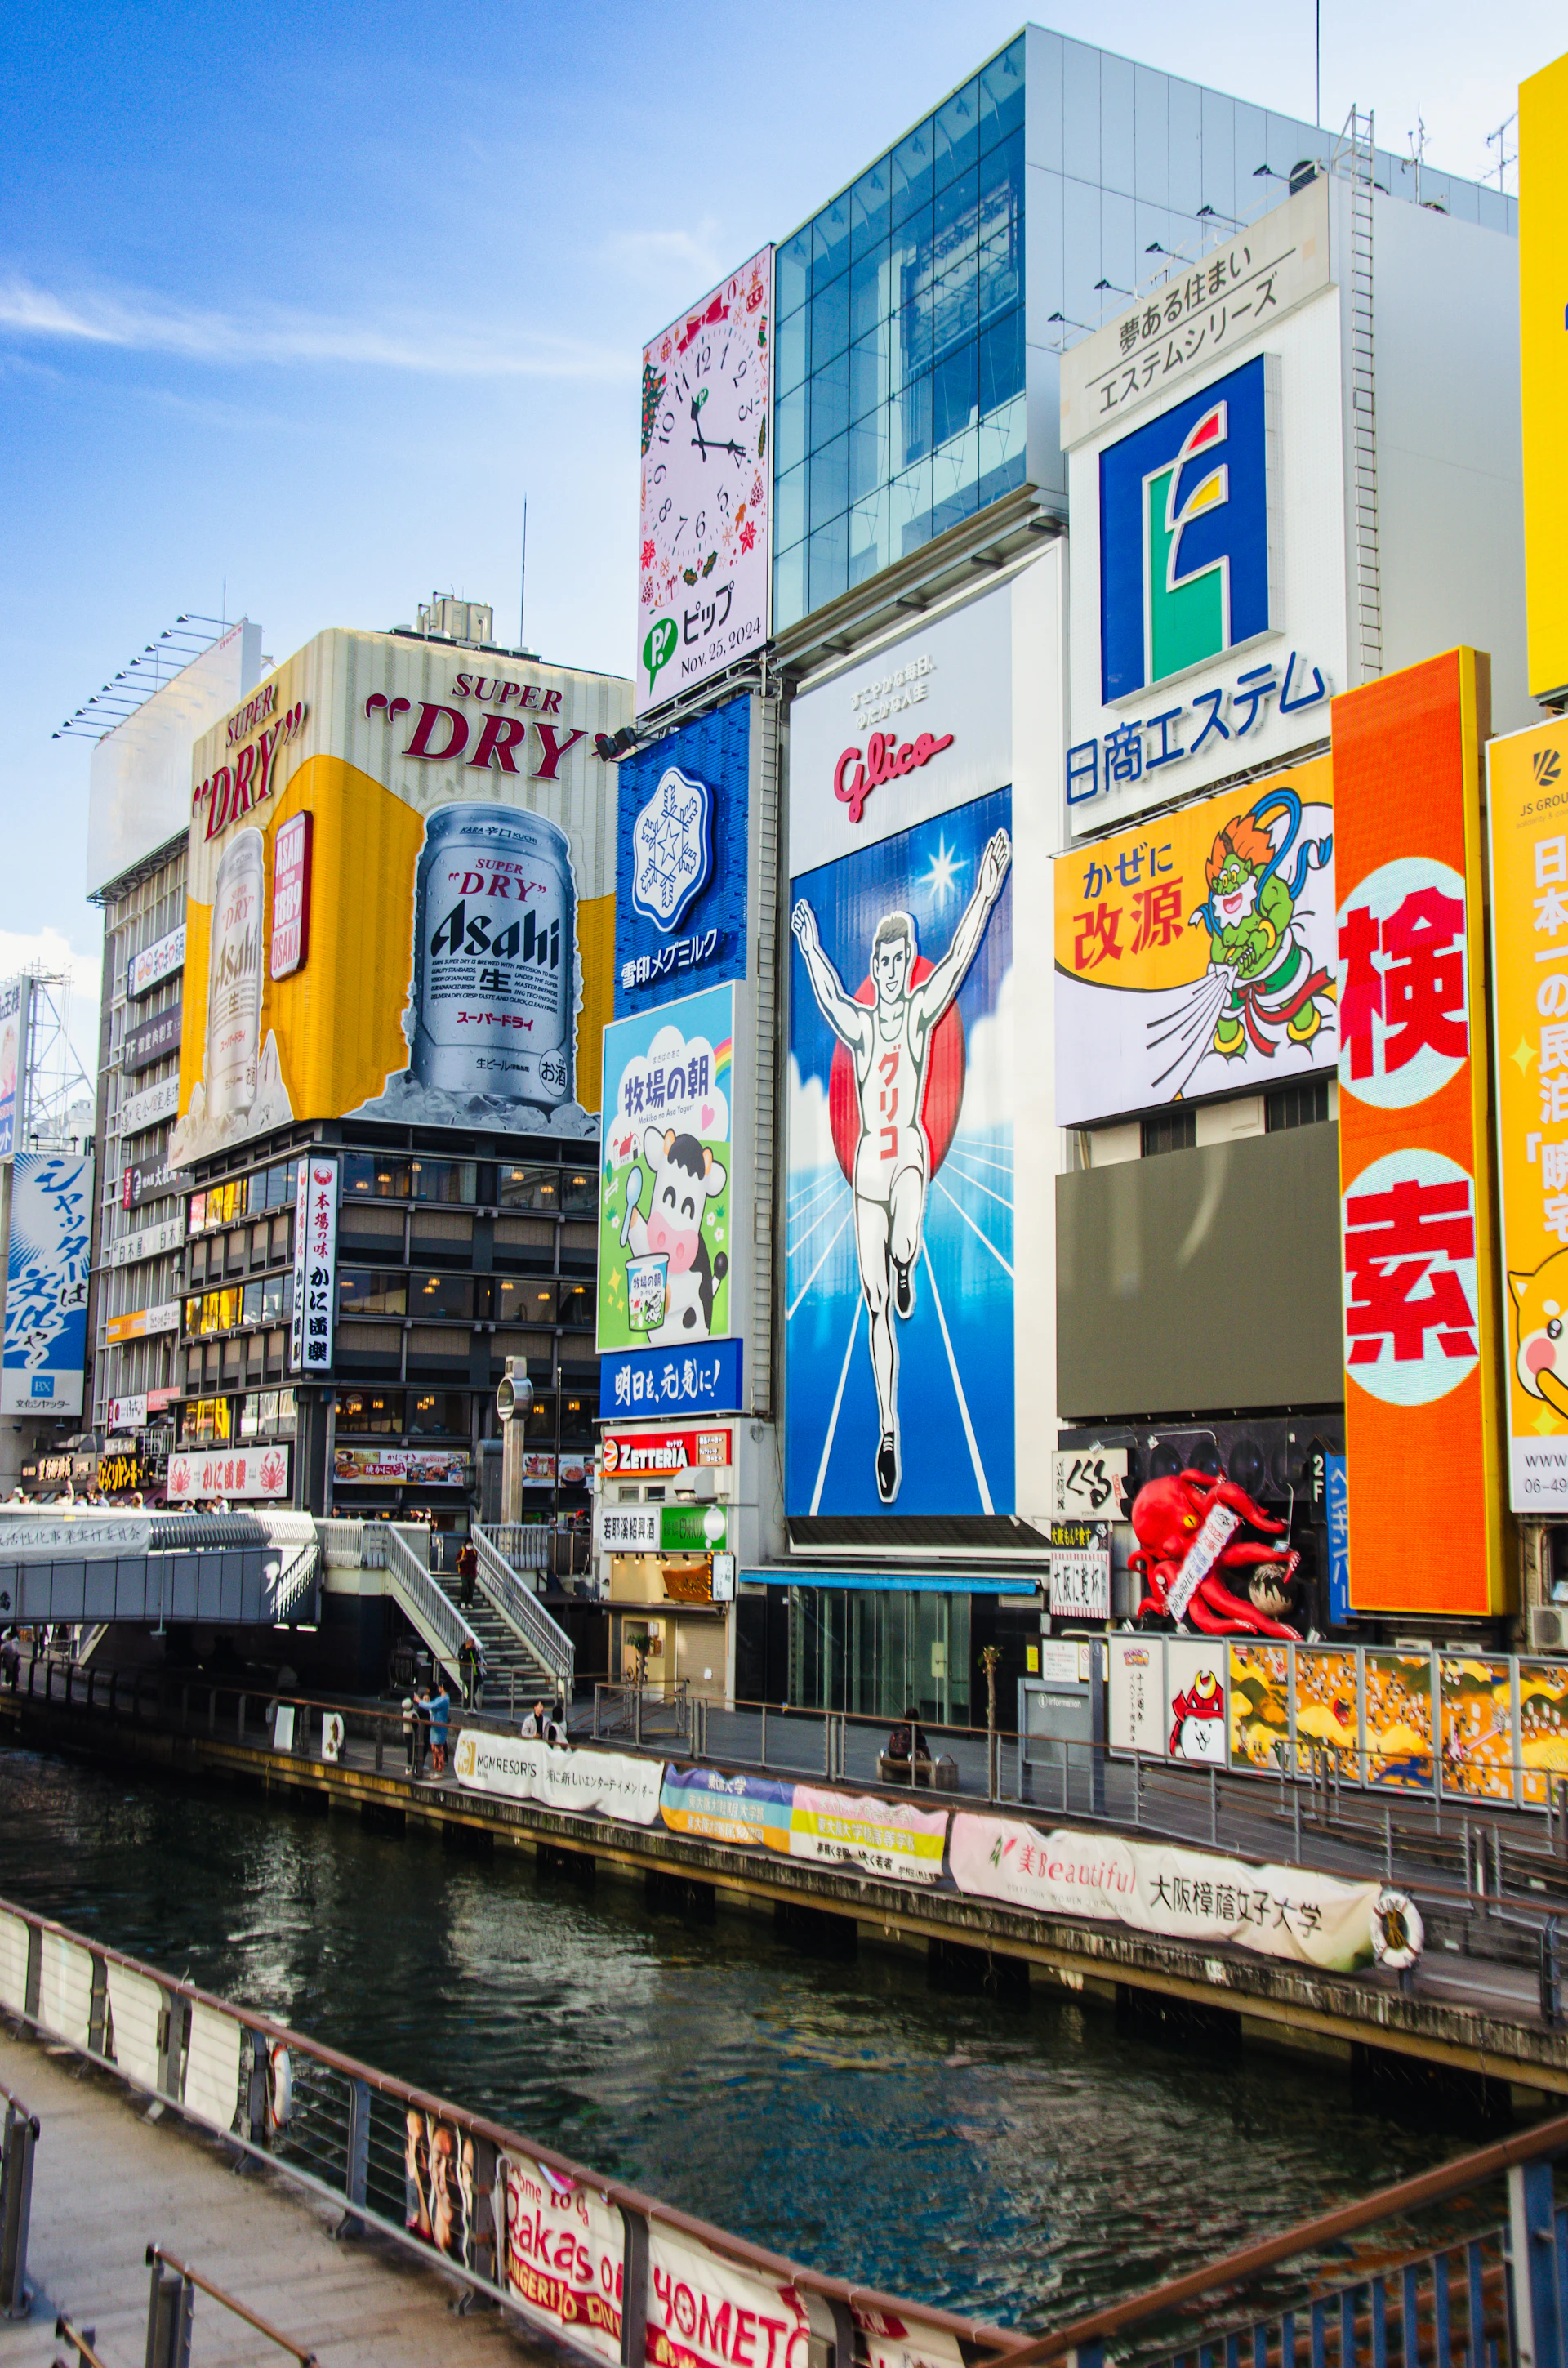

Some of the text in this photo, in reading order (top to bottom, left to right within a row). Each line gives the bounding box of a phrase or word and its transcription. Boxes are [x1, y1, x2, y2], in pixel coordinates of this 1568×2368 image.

[1120, 247, 1250, 356] 夢ある住まい
[721, 342, 729, 369] 1
[1100, 271, 1277, 414] エステムシリーズ
[695, 346, 711, 378] 12
[733, 360, 747, 388] 2
[738, 399, 753, 422] 3
[658, 412, 675, 445] 10
[653, 464, 666, 485] 9
[659, 497, 672, 523] 8
[717, 484, 728, 512] 5
[675, 515, 688, 542] 7
[696, 511, 706, 538] 6
[684, 580, 735, 646] ピップ
[681, 617, 761, 678] Nov. 25, 2024
[452, 672, 564, 715] SUPER
[850, 654, 938, 711] すこやかな毎日、
[225, 685, 276, 748] SUPER
[856, 680, 929, 730] ゆたかな人生
[1066, 651, 1328, 807] 日商エステム
[834, 732, 954, 823] Glico
[1520, 803, 1534, 817] JS
[276, 826, 304, 877] ASAHI
[512, 832, 537, 844] KUCHI
[475, 858, 523, 875] SUPER
[1083, 841, 1174, 899] かぜに
[274, 880, 301, 928] 1889
[431, 898, 559, 971] Asahi
[1072, 876, 1184, 971] 改源
[214, 921, 258, 998] Asahi
[273, 923, 299, 970] OSAKA
[621, 928, 718, 990] 雪印メグミルク
[479, 968, 512, 993] 生
[514, 973, 533, 981] UNDER
[515, 965, 541, 974] PRECISION
[514, 982, 537, 990] MASTER
[526, 992, 558, 1006] TECHNIQUES
[229, 992, 239, 1015] 生
[457, 1011, 534, 1032] スーパードライ
[126, 1039, 136, 1064] 7F
[653, 1050, 680, 1064] まきばのあさ
[541, 1061, 566, 1088] お酒
[625, 1055, 709, 1118] 牧場の朝
[638, 1113, 657, 1125] Makiba
[666, 1108, 676, 1117] Asa
[677, 1104, 694, 1115] Yogurt
[877, 1043, 901, 1160] グリコ
[1338, 886, 1478, 1365] 検索
[125, 1172, 131, 1206] 5F
[313, 1191, 330, 1260] 本場の味
[633, 1273, 662, 1291] 牧場の朝
[308, 1266, 330, 1362] かに道楽
[34, 1381, 51, 1393] BX
[387, 1453, 416, 1462] かにすき
[620, 1444, 688, 1470] ZETTERIA
[203, 1459, 246, 1491] かに道楽
[1067, 1459, 1112, 1510] くくる
[1313, 1454, 1324, 1502] 2F
[1051, 1526, 1092, 1546] 大阪もんを食す
[1207, 1523, 1226, 1543] 2025
[1054, 1562, 1100, 1605] 大阪に乾杯
[1049, 1697, 1081, 1709] information
[477, 1755, 537, 1778] MGM RESORTS
[1150, 1875, 1322, 1938] 大阪樟蔭女子大学
